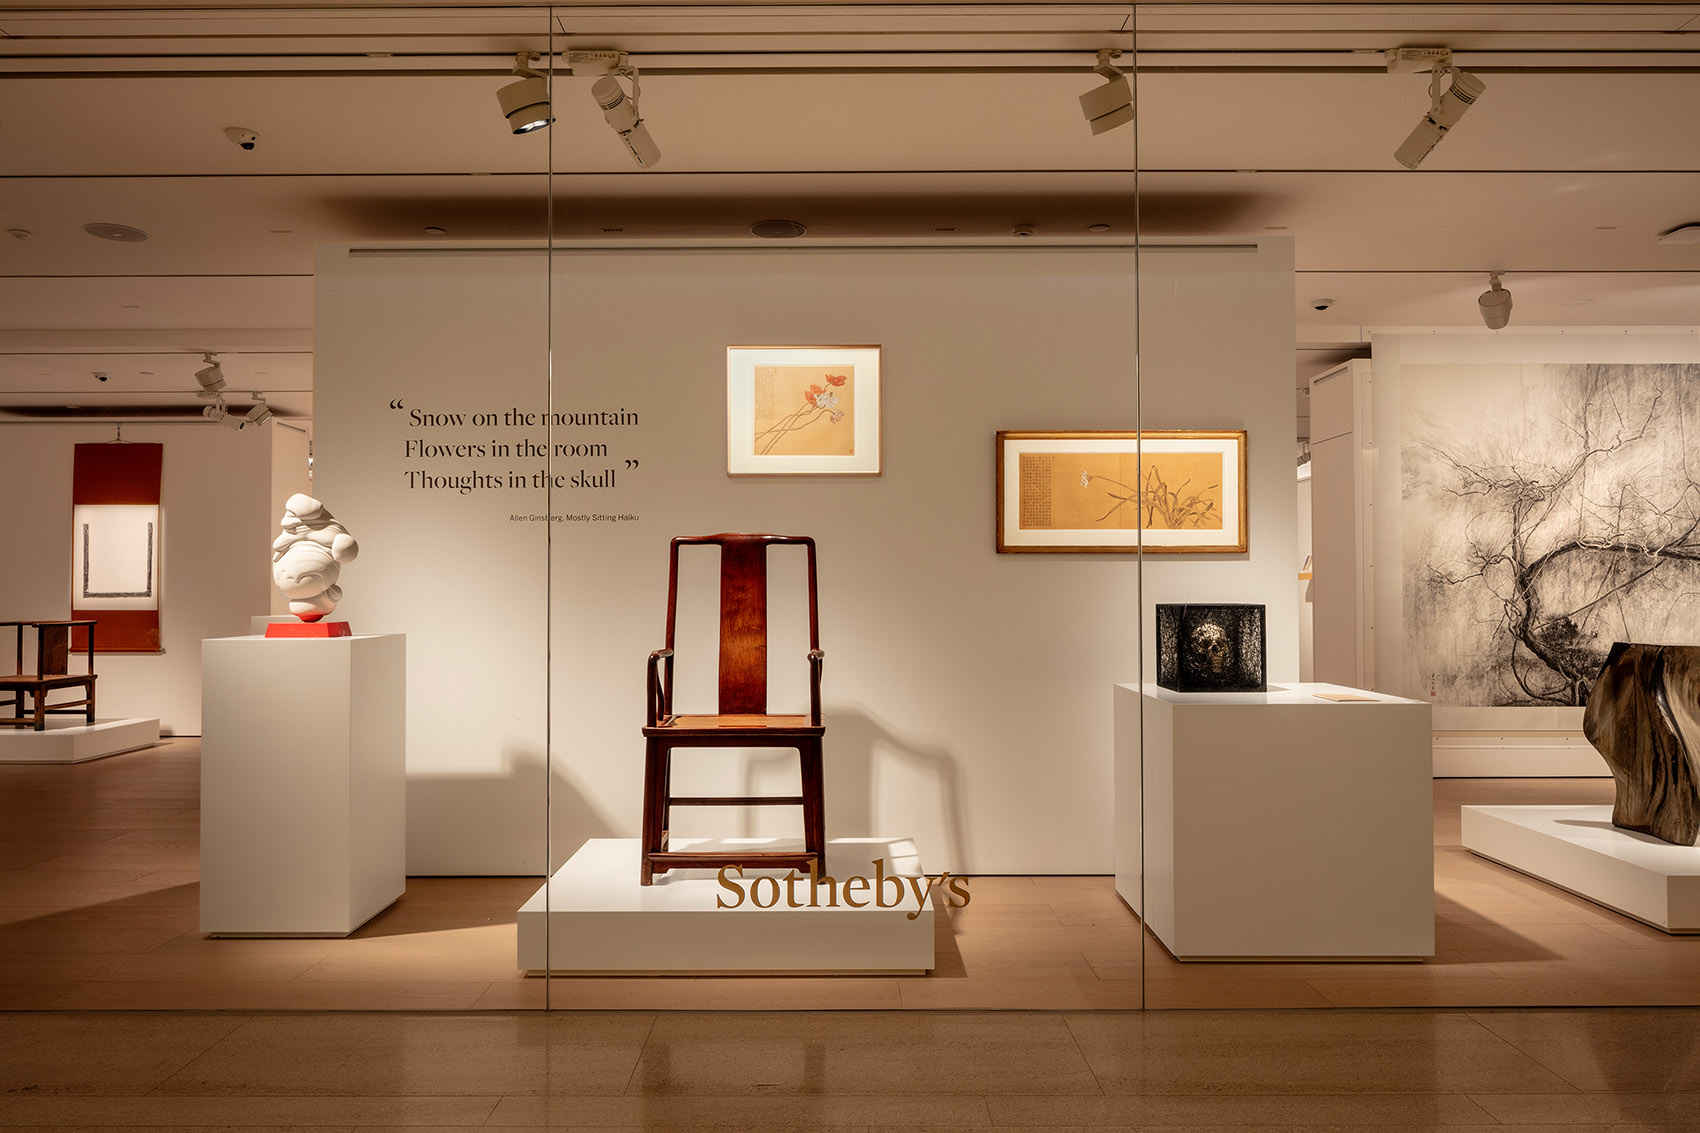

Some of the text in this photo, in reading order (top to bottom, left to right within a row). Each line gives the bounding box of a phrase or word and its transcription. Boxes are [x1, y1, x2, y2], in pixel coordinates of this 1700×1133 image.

[409, 408, 467, 428] Snow
[472, 413, 498, 427] on
[504, 407, 536, 427] the
[541, 407, 639, 427] mountain
[404, 438, 608, 458] Flowers in the room
[404, 469, 503, 496] Thoughts
[508, 470, 527, 489] in
[532, 469, 566, 489] the
[570, 468, 616, 488] skull
[509, 514, 528, 522] Allen
[566, 514, 591, 523] Mostly
[592, 513, 617, 523] Sitting
[618, 513, 640, 522] Haiku
[716, 858, 971, 921] Sotheby's
